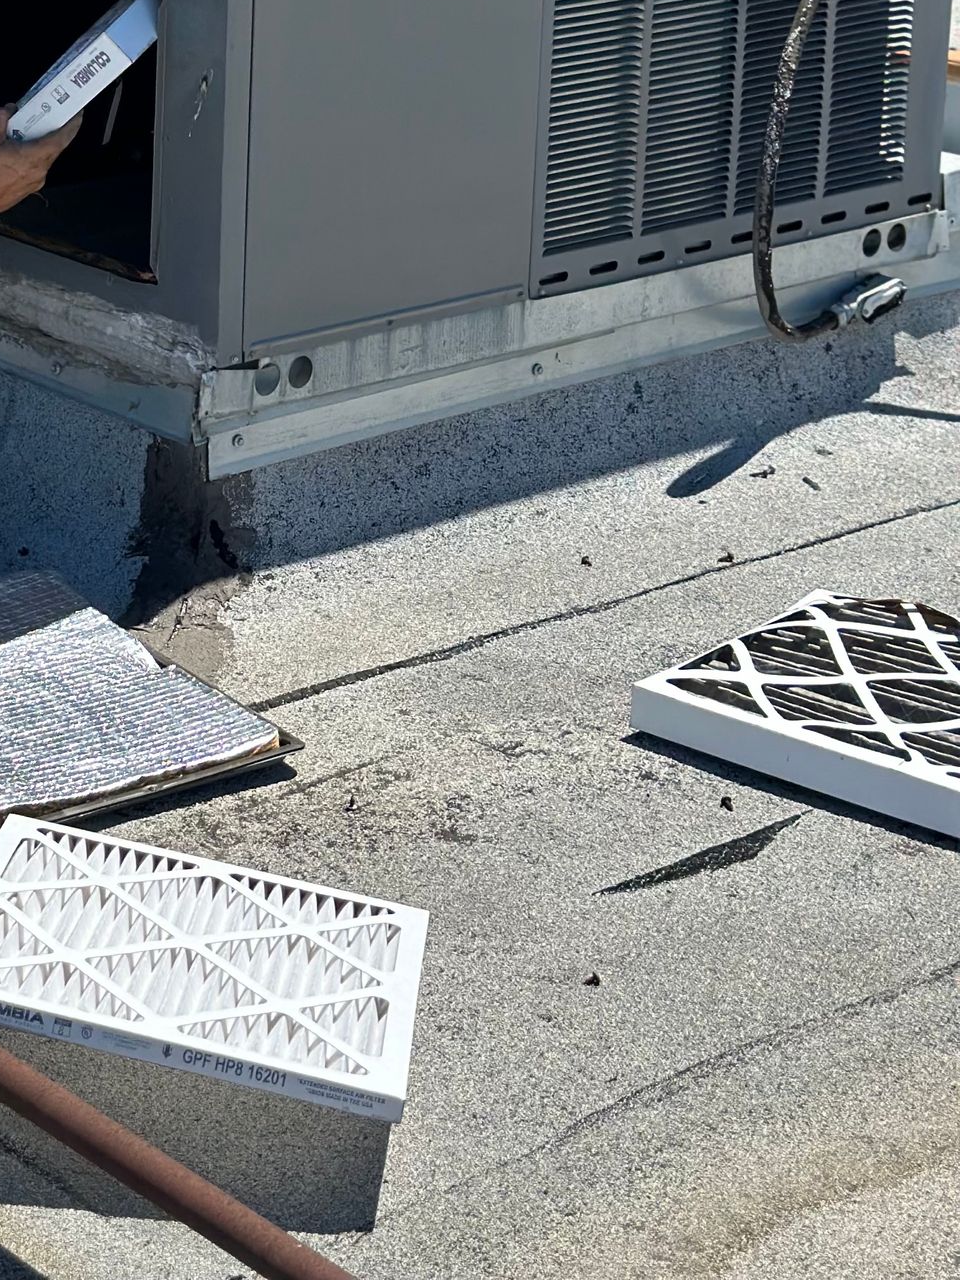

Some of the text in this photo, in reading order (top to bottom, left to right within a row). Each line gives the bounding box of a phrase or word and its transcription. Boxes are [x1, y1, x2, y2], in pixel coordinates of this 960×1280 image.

[70, 51, 112, 89] COLUMBIA
[182, 1049, 287, 1088] GPF HP8 16201
